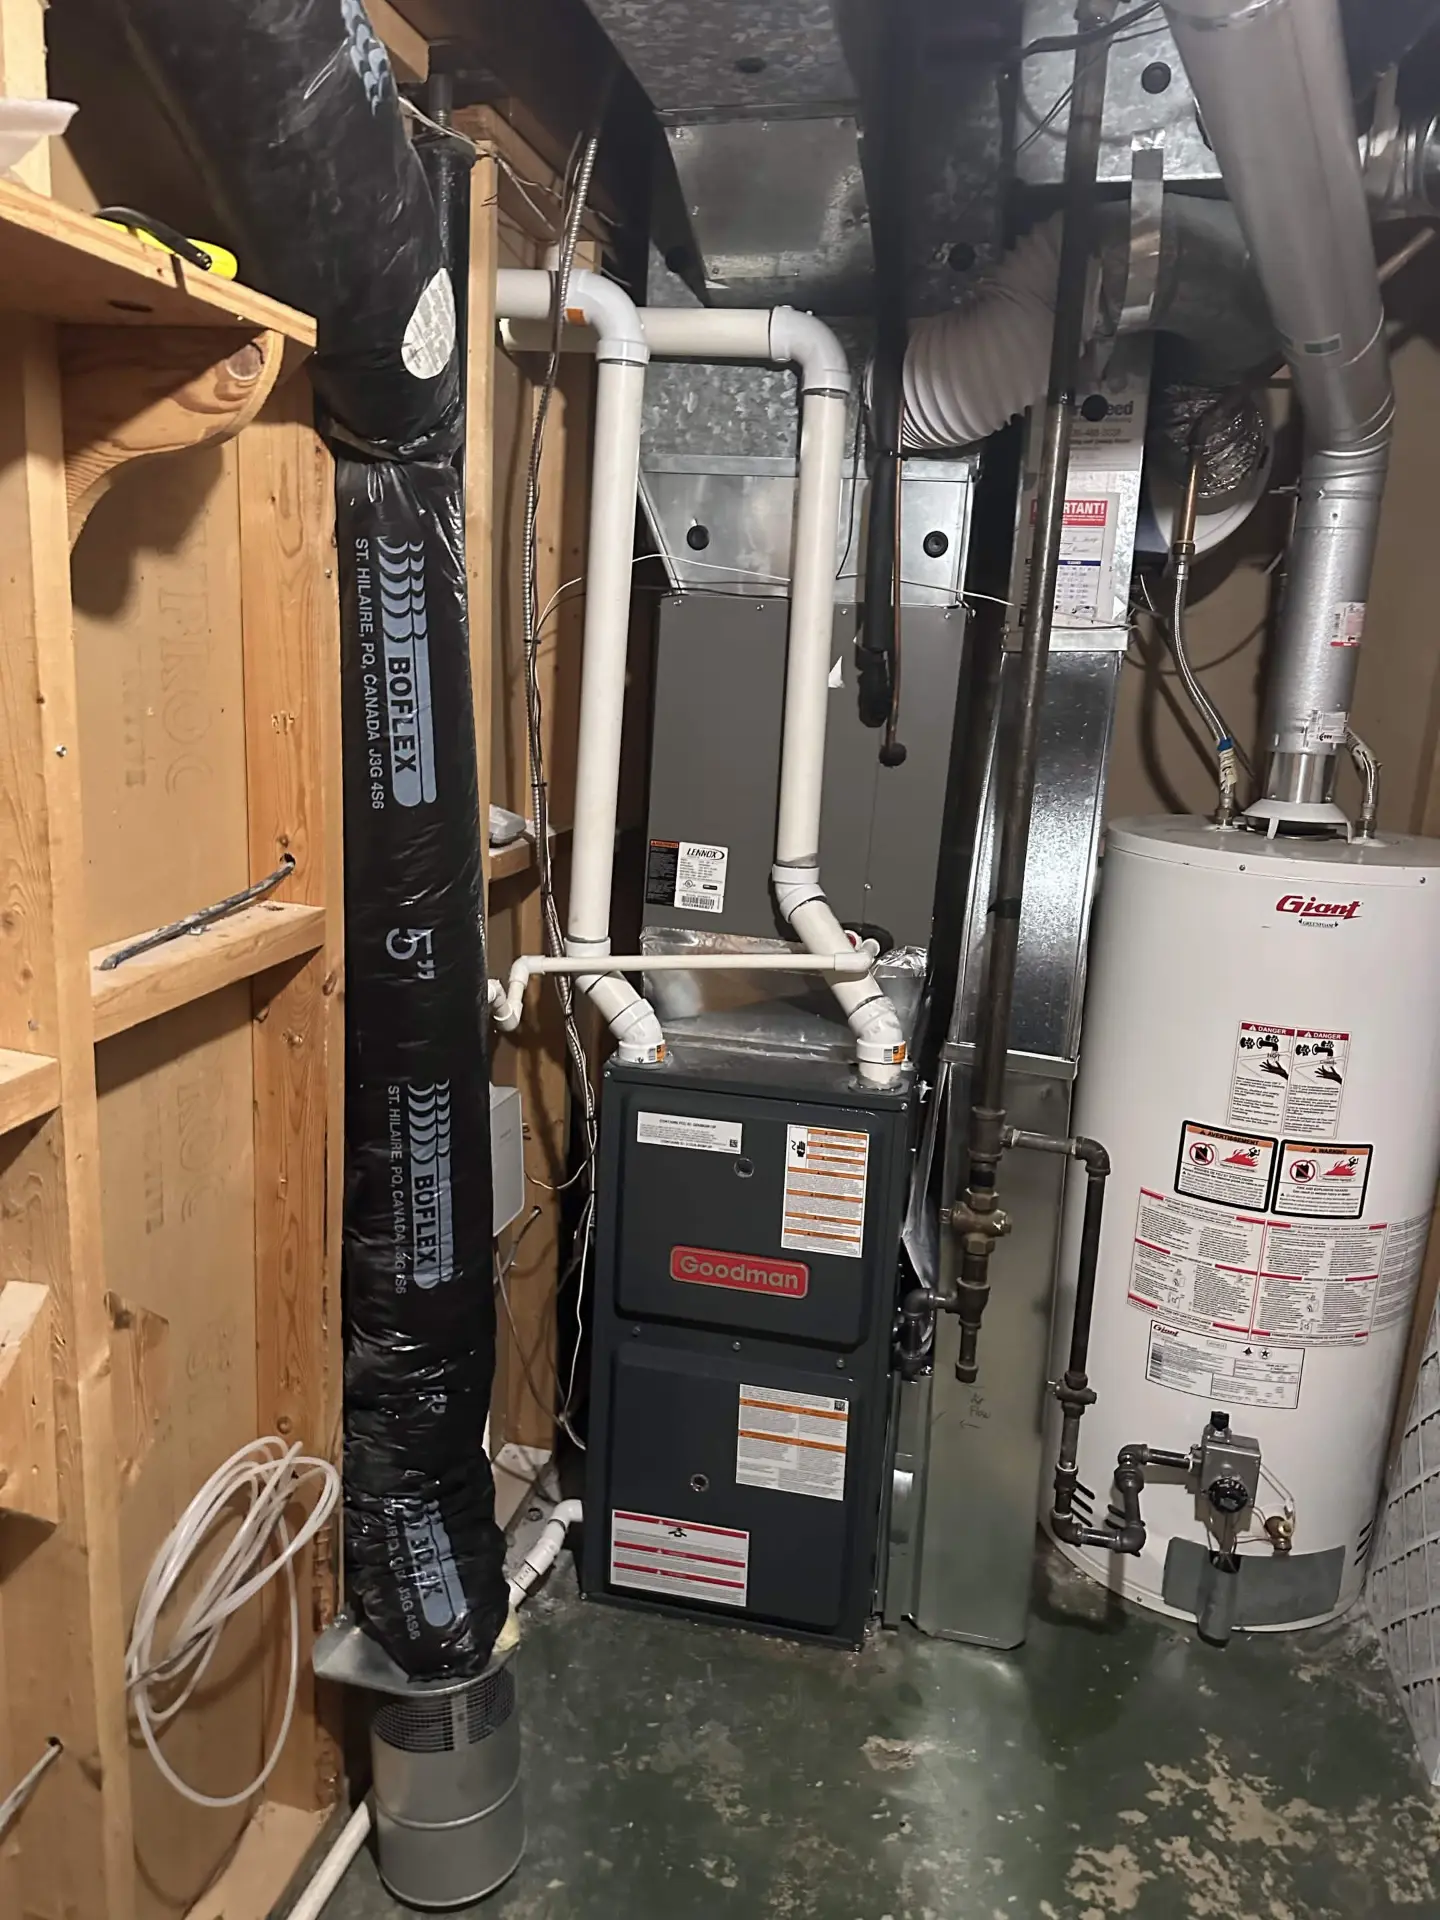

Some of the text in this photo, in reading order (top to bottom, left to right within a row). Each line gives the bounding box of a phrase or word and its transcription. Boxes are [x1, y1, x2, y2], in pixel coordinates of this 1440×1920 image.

[355, 538, 385, 810] ST. HILAIRE, PQ, CANADA J3G 4S6
[388, 656, 417, 774] BOFLEX
[687, 847, 717, 859] LENNOX
[1276, 895, 1362, 920] Giant
[1258, 1026, 1287, 1035] DANGER
[387, 1085, 401, 1105] ST.
[1207, 1130, 1260, 1146] AVERTISSEMENT
[1318, 1147, 1348, 1155] WARNING
[391, 1190, 407, 1240] CANADA
[415, 1173, 437, 1266] BOFLEX
[679, 1255, 799, 1290] Goodman
